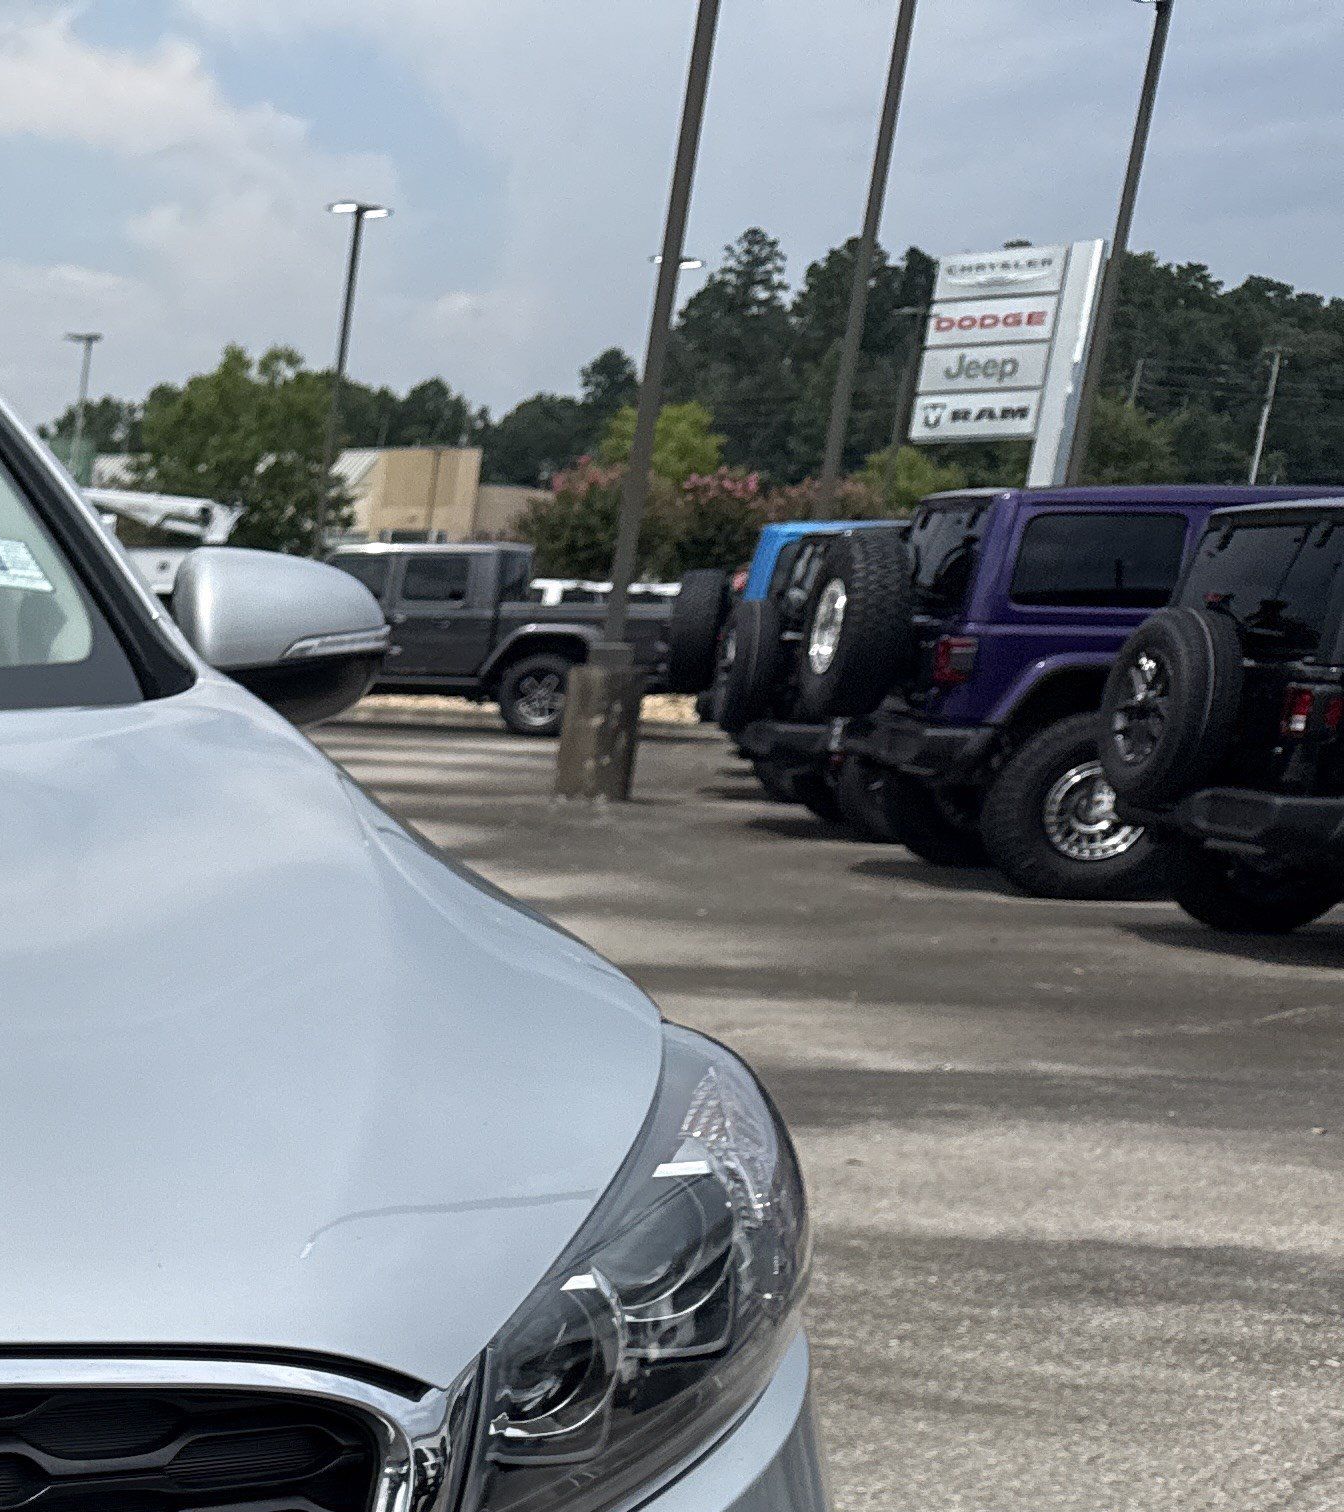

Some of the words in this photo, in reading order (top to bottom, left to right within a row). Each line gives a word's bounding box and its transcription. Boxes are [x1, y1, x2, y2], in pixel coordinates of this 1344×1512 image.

[935, 311, 1047, 332] DODGE
[943, 353, 1019, 383] Jeep
[950, 405, 1030, 423] RAM
